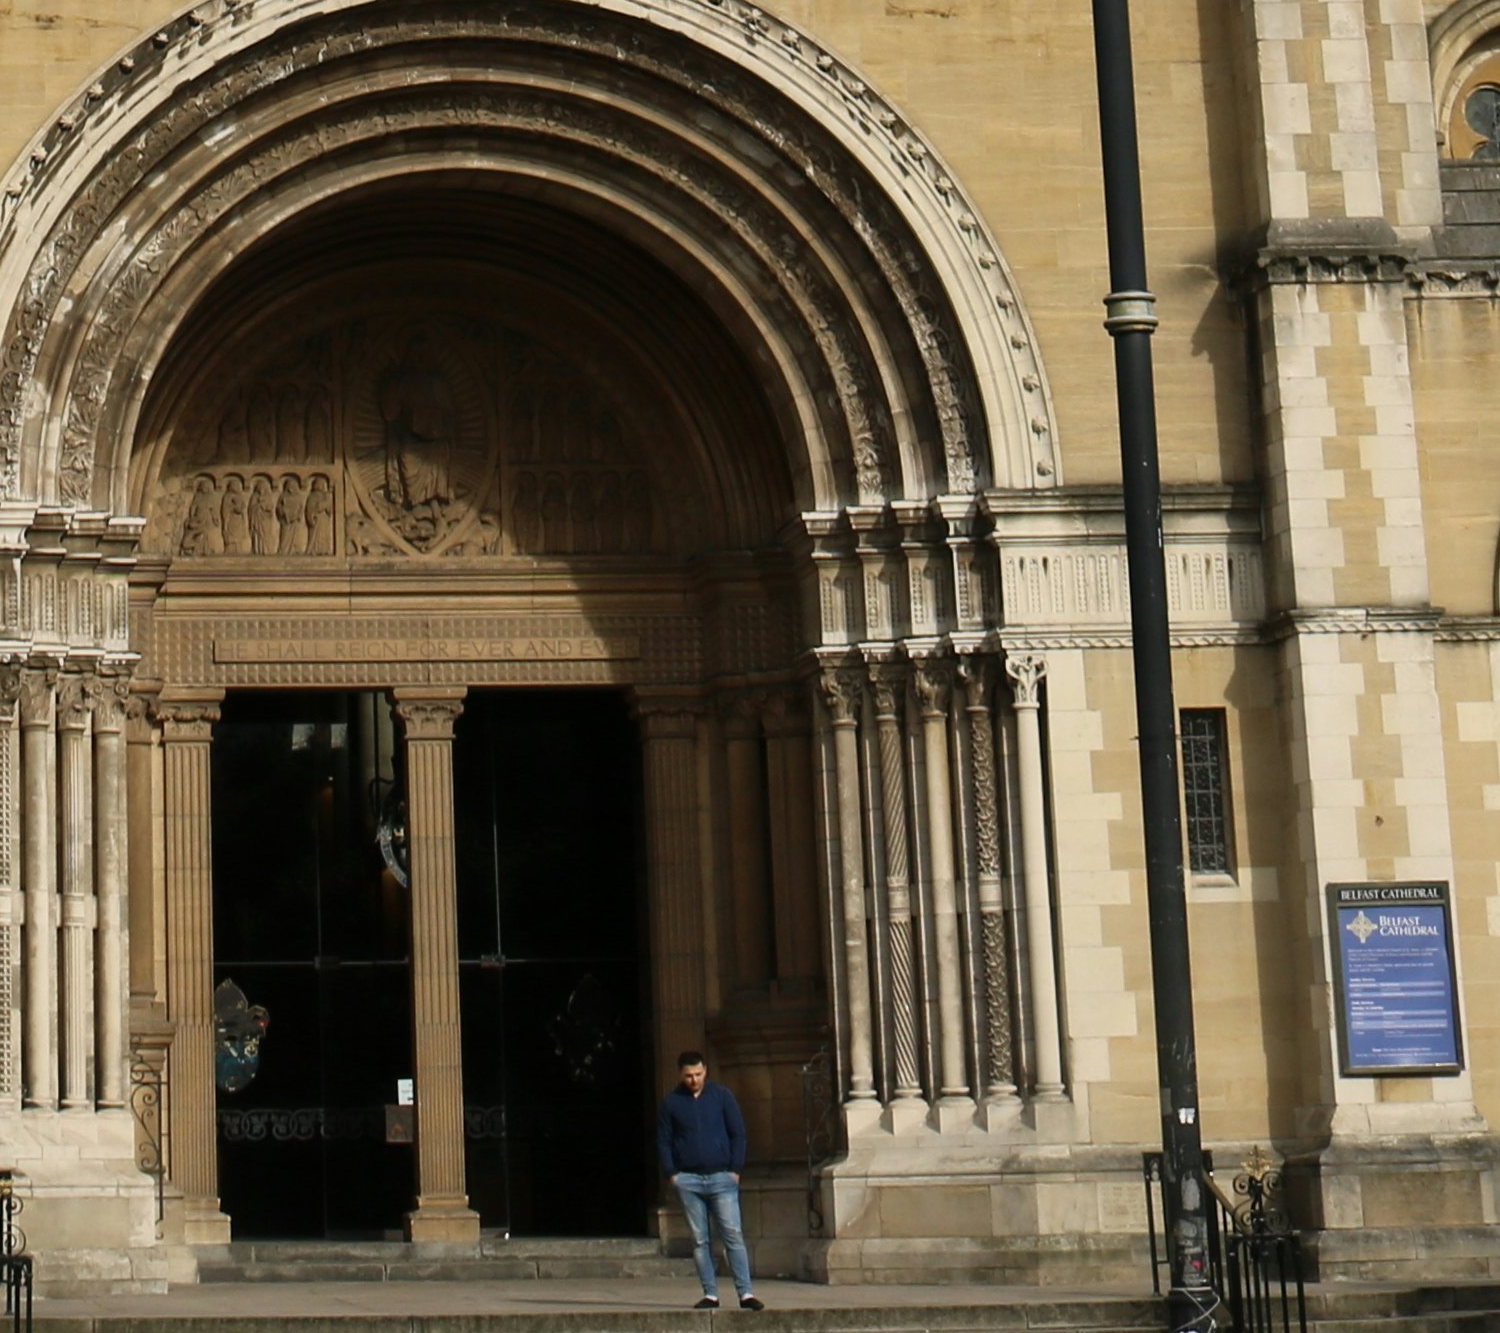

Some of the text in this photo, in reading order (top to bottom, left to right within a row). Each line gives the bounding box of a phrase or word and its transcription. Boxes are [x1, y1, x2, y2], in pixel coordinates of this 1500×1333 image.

[218, 640, 639, 659] HE SHALL REIGN FOR EVER AND EVER
[1341, 887, 1440, 901] BELFAST CATHEDRAL
[1379, 915, 1421, 926] BELFAST
[1379, 925, 1440, 937] CATHEDRAL
